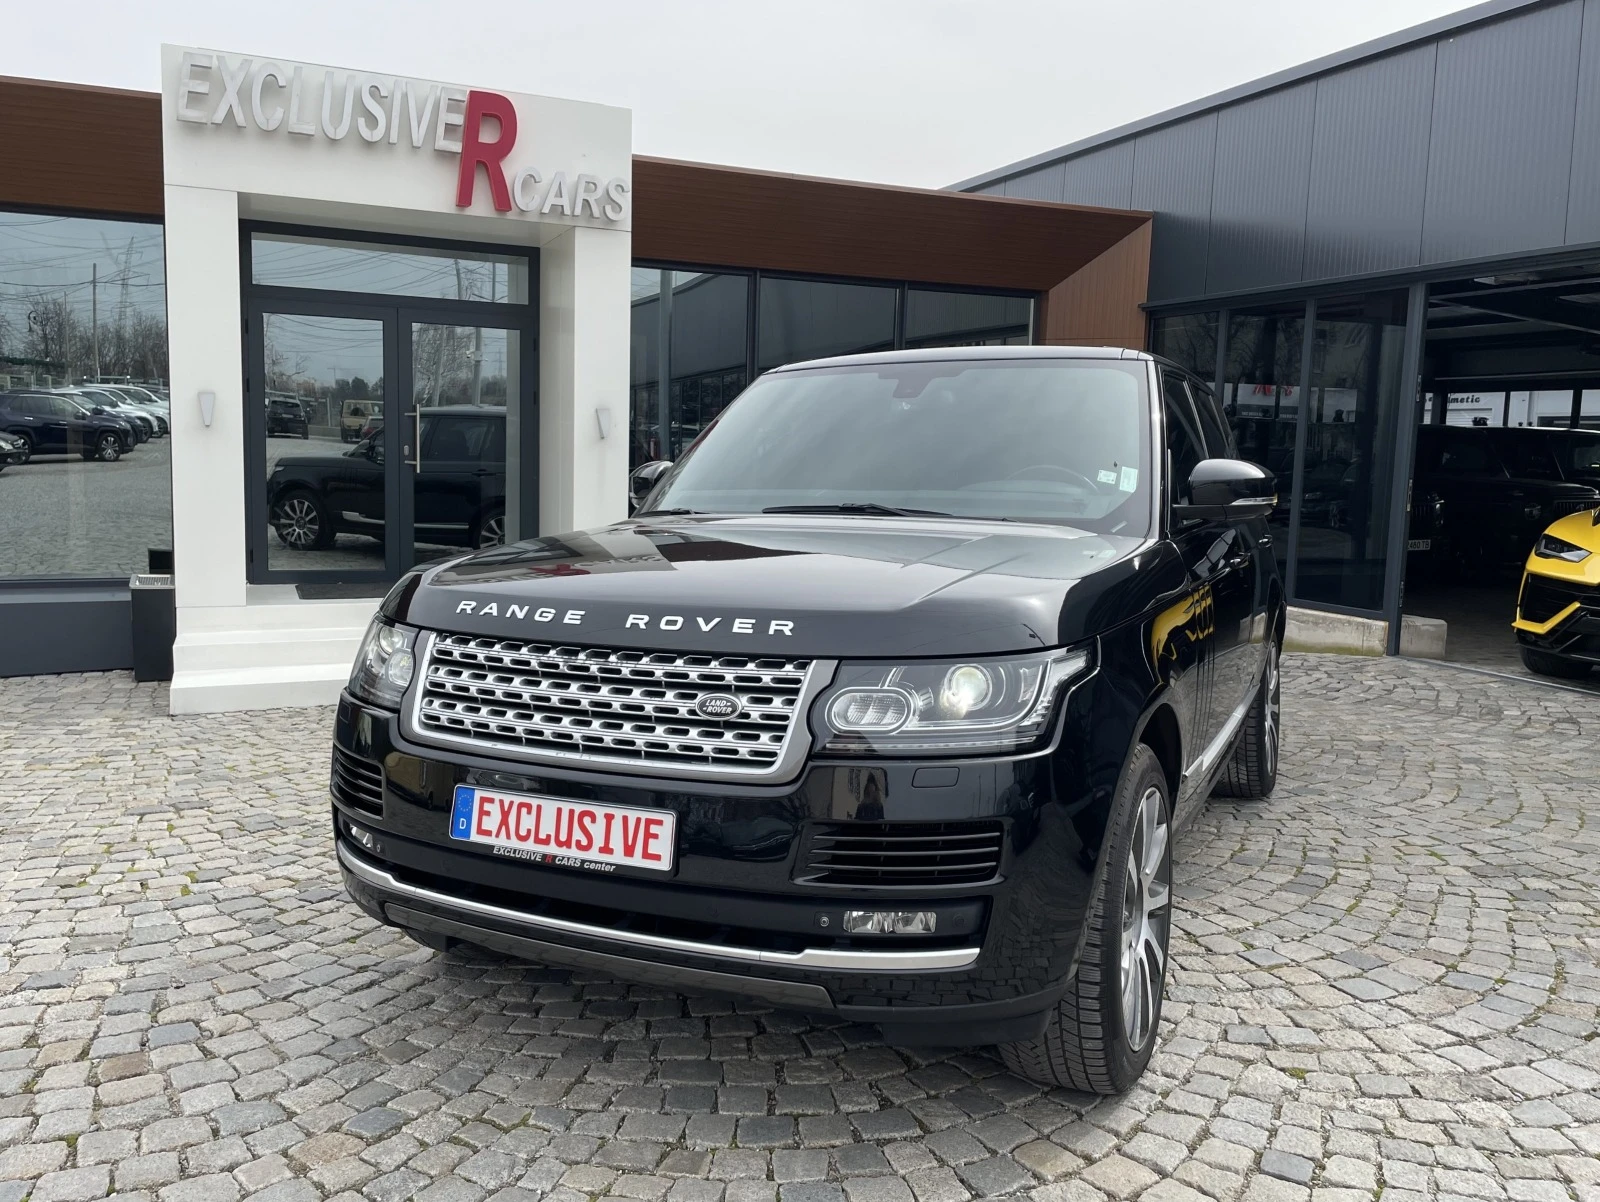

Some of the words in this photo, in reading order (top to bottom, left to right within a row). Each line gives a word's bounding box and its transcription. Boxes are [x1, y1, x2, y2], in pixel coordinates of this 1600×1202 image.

[176, 51, 467, 153] EXCLUSIVE
[455, 90, 518, 212] R
[513, 166, 630, 222] CARS
[455, 600, 586, 625] RANGE
[625, 614, 795, 636] ROVER
[459, 817, 467, 829] D
[476, 796, 664, 862] EXCLUSIVE
[493, 845, 542, 862] EXCLUSIVE
[545, 854, 553, 864] R
[555, 856, 581, 868] CARS
[584, 860, 616, 872] center
